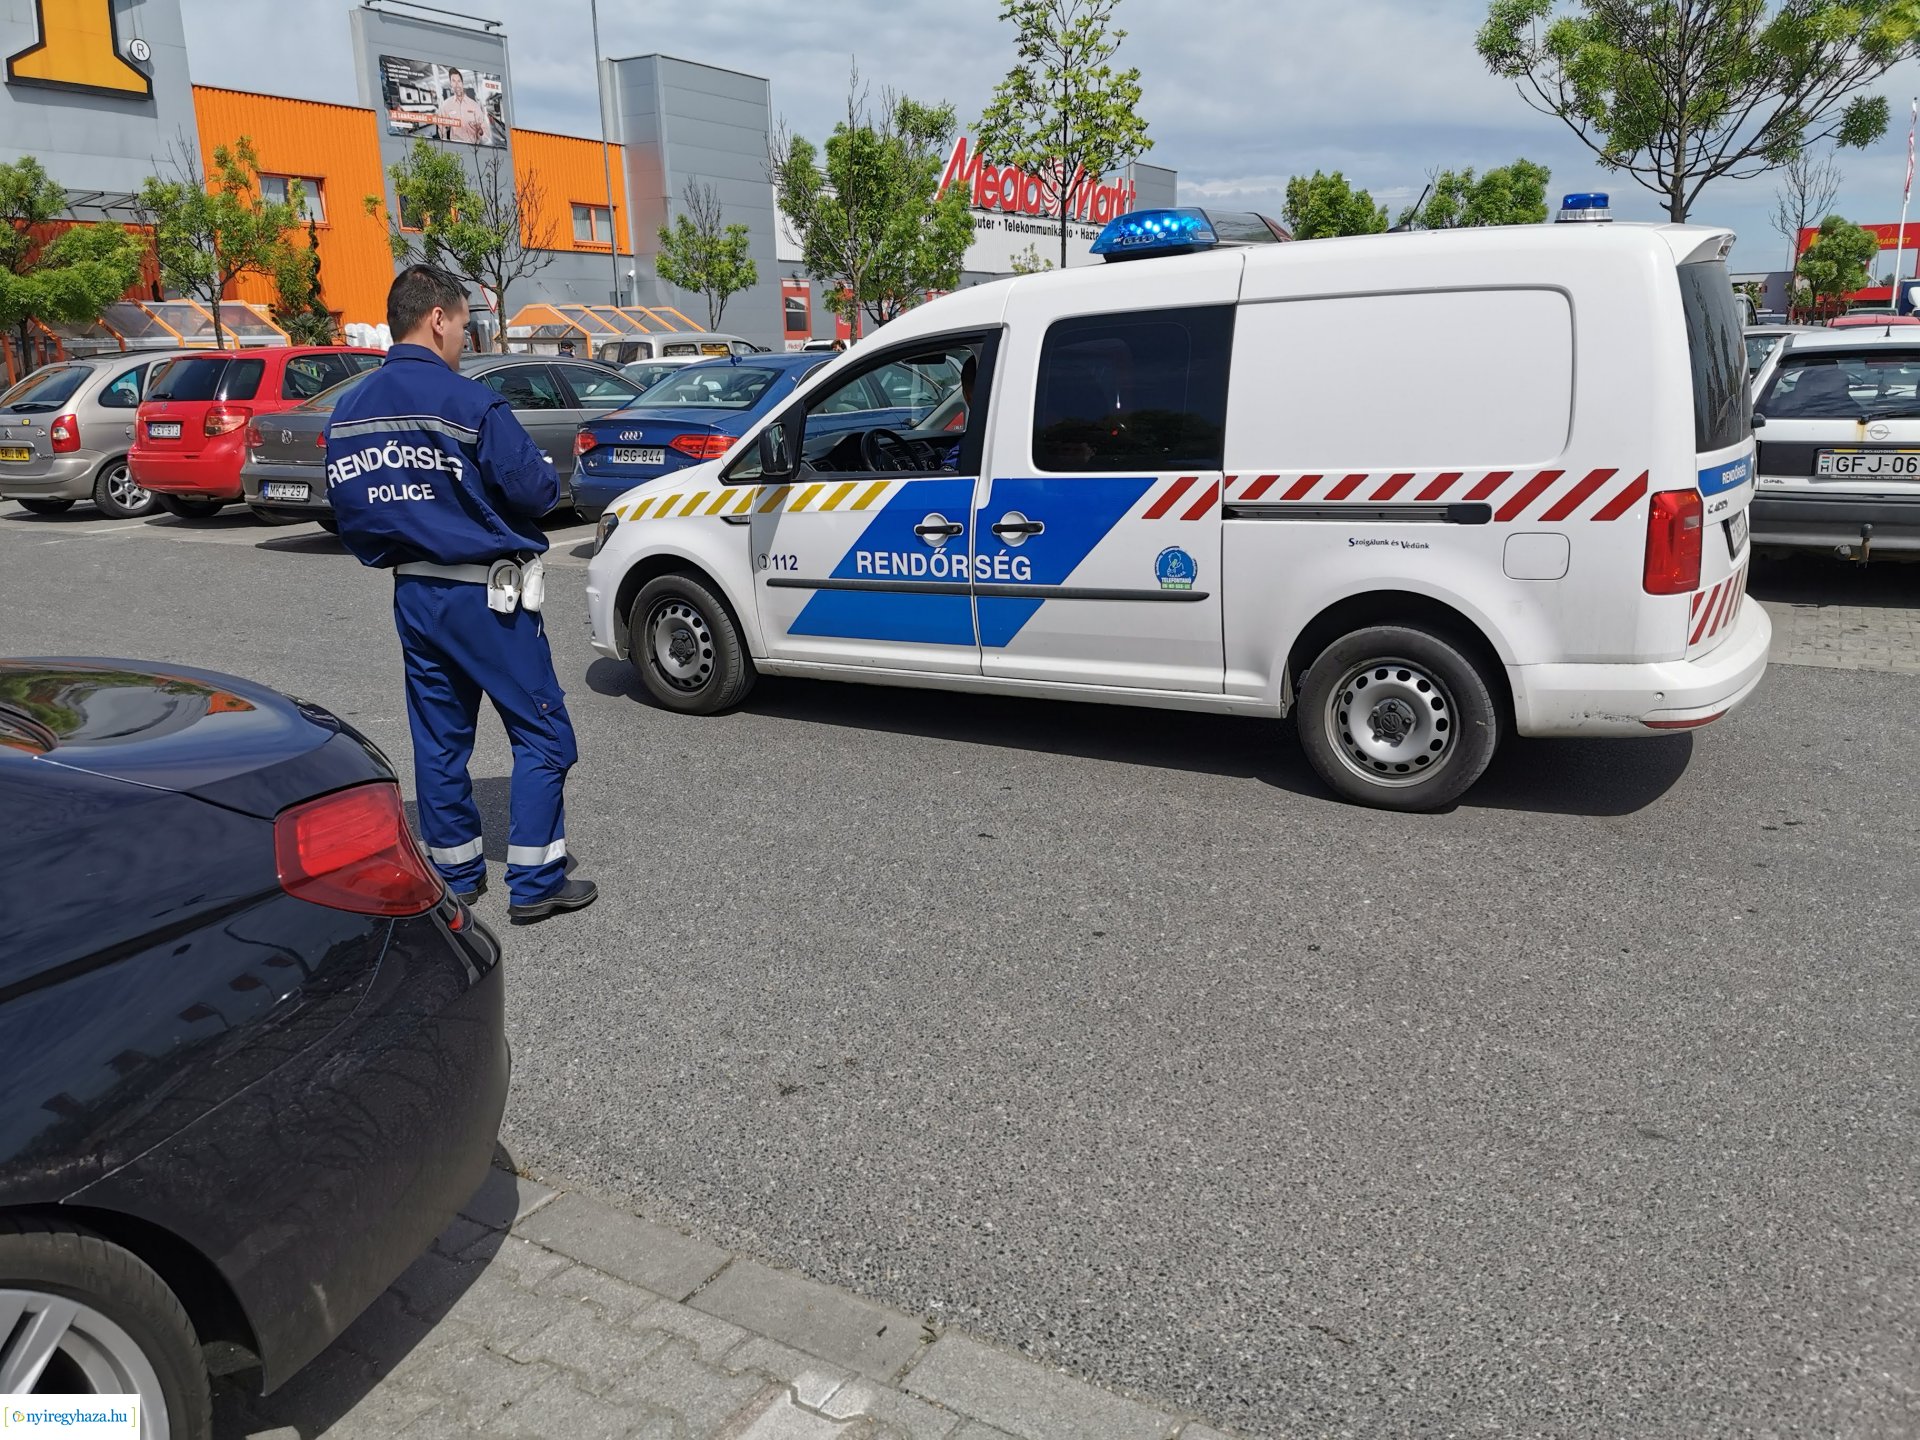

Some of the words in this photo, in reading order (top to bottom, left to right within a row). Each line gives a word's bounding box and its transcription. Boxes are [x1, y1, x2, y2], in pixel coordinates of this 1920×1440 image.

[615, 448, 661, 463] MSG-844
[269, 483, 307, 496] MKA-297
[368, 484, 435, 503] POLICE
[772, 554, 799, 571] 112
[856, 547, 1032, 581] RENDŐRSÉG
